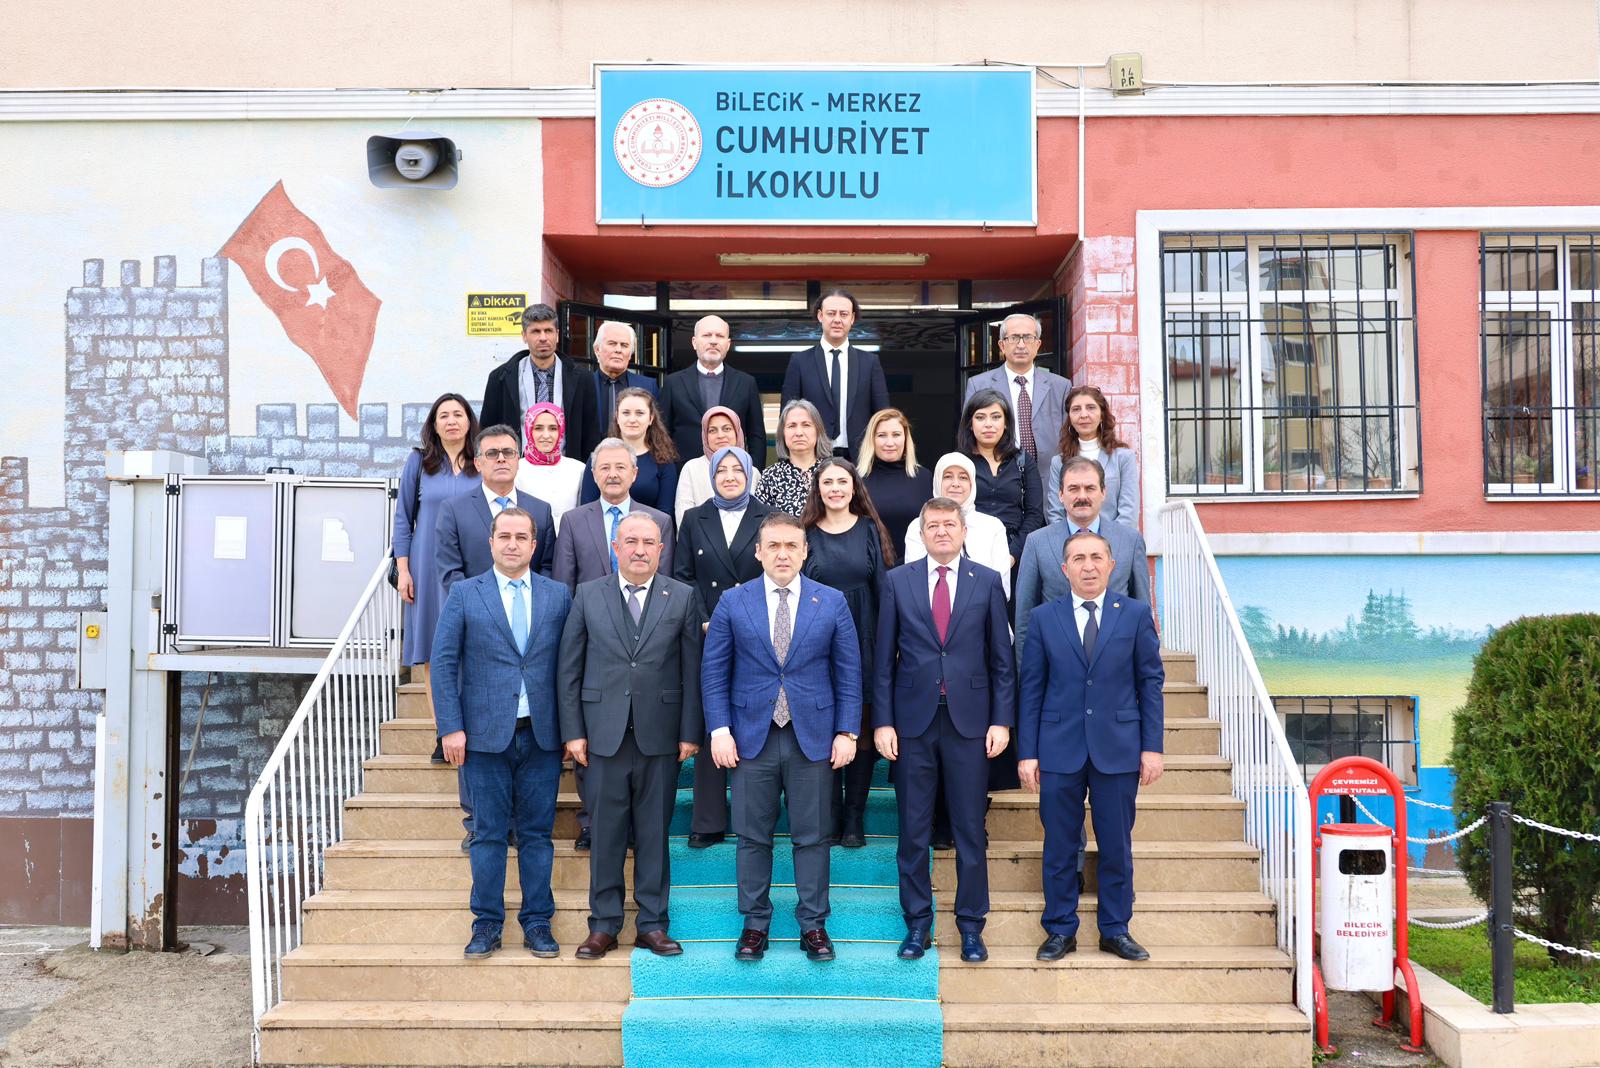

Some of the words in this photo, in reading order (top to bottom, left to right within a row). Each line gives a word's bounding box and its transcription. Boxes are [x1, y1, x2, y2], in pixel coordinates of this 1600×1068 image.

[827, 92, 921, 113] MERKEZ
[715, 120, 930, 155] CUMHURİYET
[716, 163, 880, 199] İLKOKULU
[483, 296, 521, 306] DİKKAT
[1332, 778, 1379, 786] ÇEVREMİZİ
